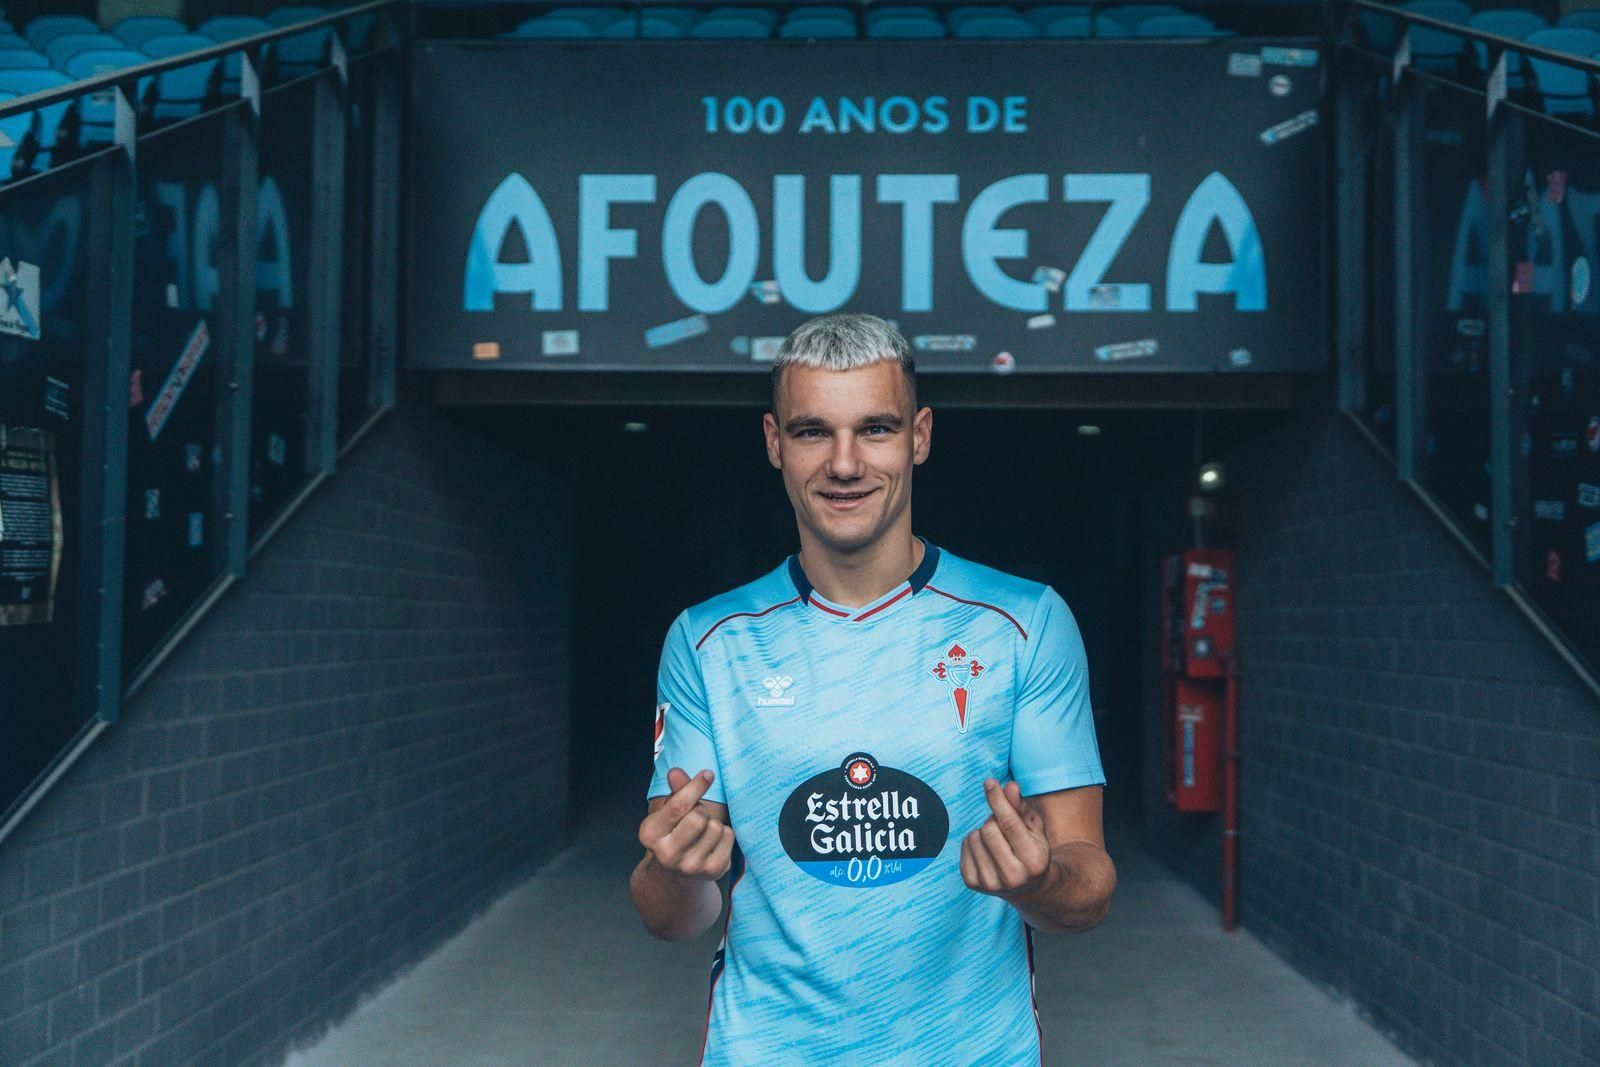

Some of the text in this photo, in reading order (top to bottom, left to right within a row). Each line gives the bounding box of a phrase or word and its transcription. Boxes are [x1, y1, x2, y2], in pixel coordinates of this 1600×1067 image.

[704, 96, 1027, 134] 100 ANOS DE
[463, 171, 1267, 314] AFOUTEZA
[758, 696, 795, 705] hummel
[804, 790, 921, 823] Estrella
[810, 821, 917, 854] Galicia
[847, 855, 883, 883] 0,0
